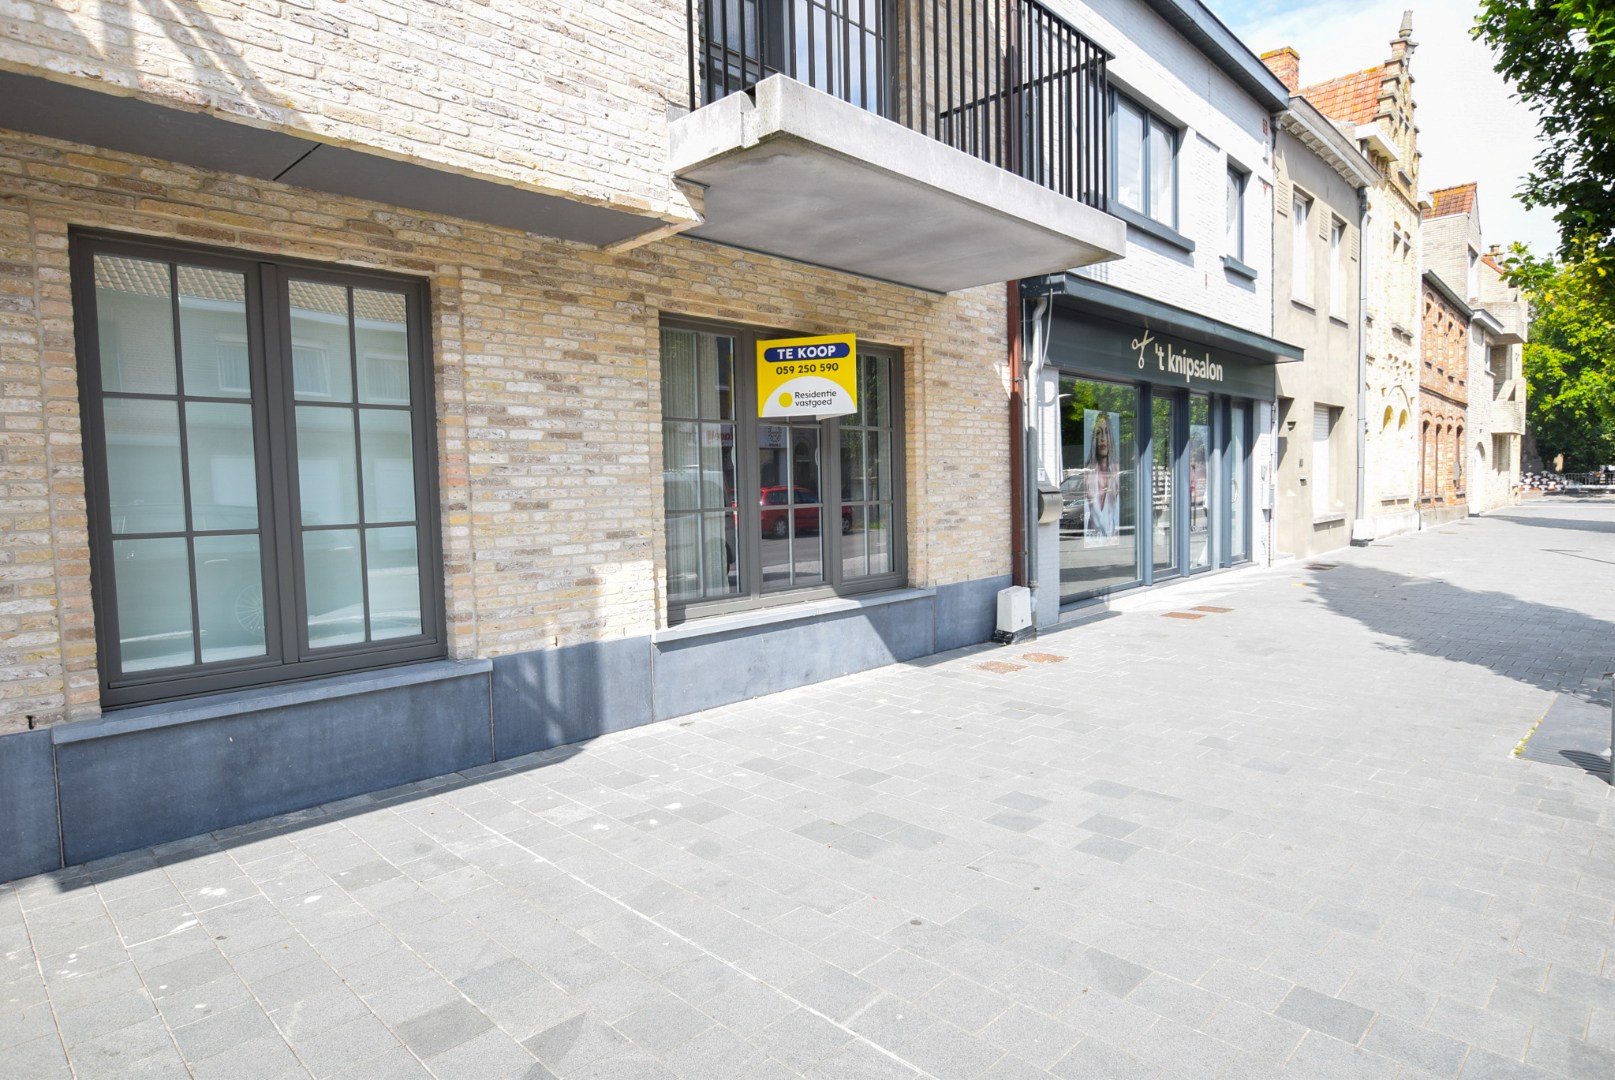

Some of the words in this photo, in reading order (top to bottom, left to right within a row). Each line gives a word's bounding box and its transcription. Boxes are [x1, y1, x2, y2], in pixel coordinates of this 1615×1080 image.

[777, 348, 794, 360] TE
[797, 345, 836, 358] KOOP
[776, 365, 795, 375] 059
[798, 364, 816, 374] 250
[820, 362, 839, 372] 590
[1155, 343, 1165, 371] 't
[1168, 343, 1223, 383] knipsalon
[794, 389, 837, 399] Residentie
[795, 398, 832, 408] vastgoed
